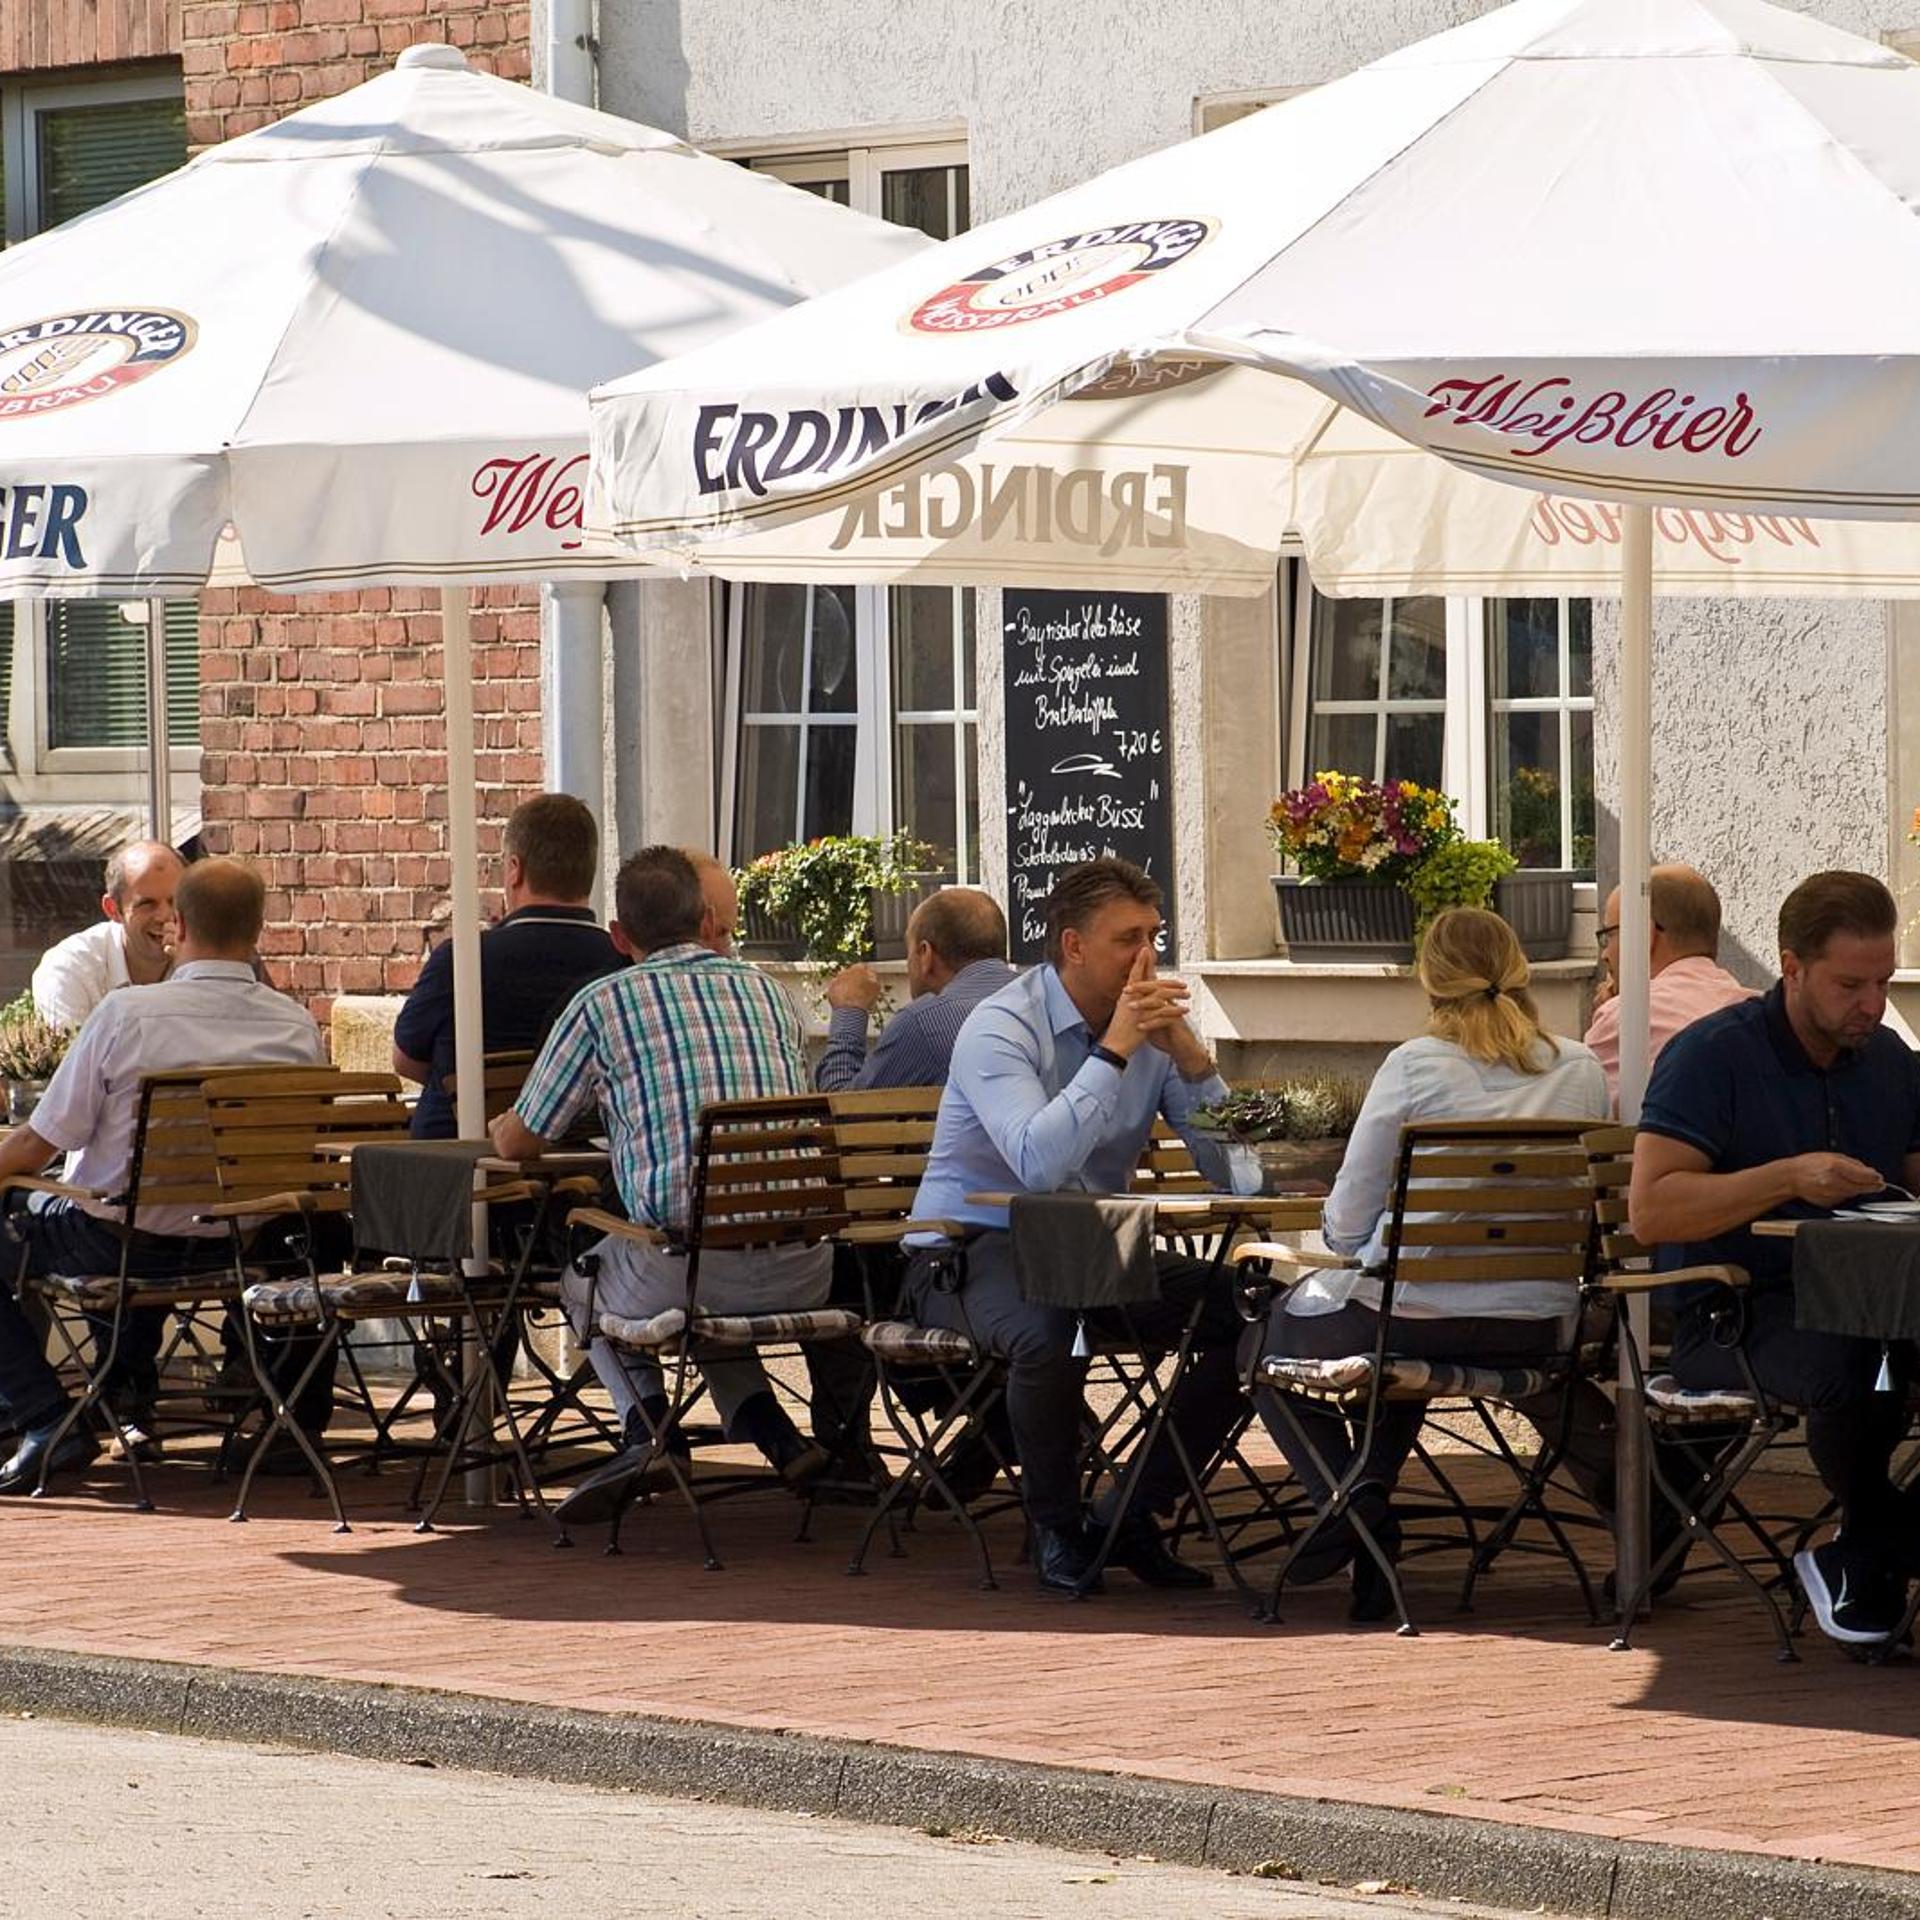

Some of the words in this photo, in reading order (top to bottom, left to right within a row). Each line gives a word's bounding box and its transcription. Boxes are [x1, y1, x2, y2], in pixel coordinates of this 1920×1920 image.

[692, 371, 1020, 495] ERDIN
[1424, 374, 1762, 457] Weißbier
[0, 484, 88, 569] ER
[472, 453, 590, 549] We
[1014, 661, 1047, 687] mit
